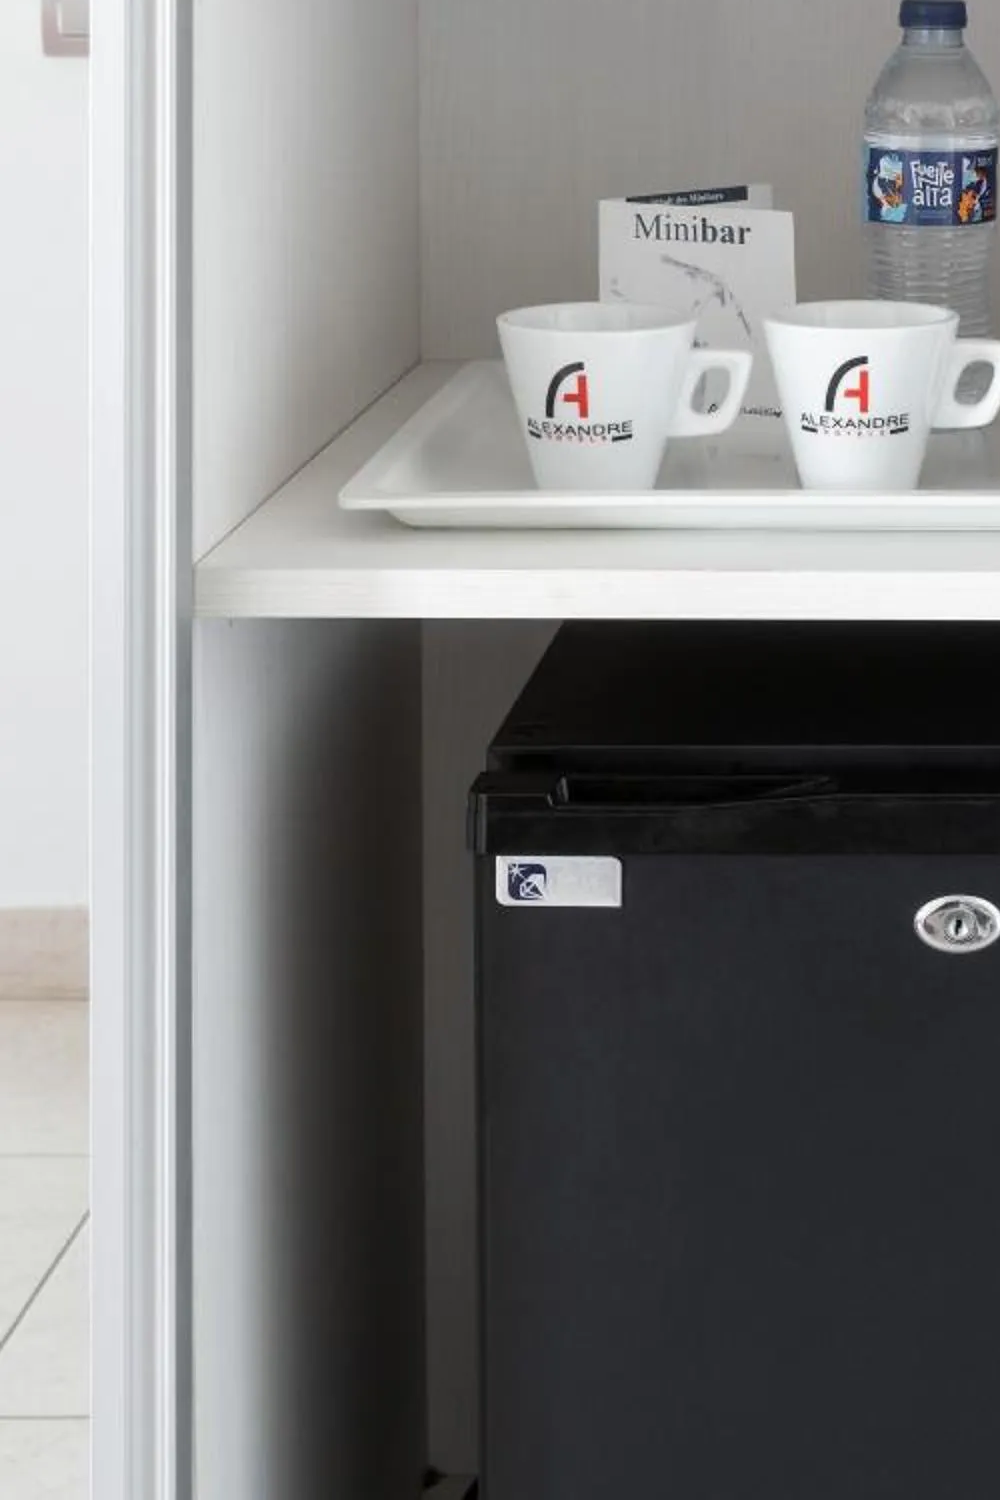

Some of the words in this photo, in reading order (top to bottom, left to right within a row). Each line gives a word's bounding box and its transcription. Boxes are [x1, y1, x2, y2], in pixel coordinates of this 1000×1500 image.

[634, 213, 752, 245] Minibar
[527, 417, 633, 437] ALEXANDRE
[800, 411, 910, 429] ALEXANDRE
